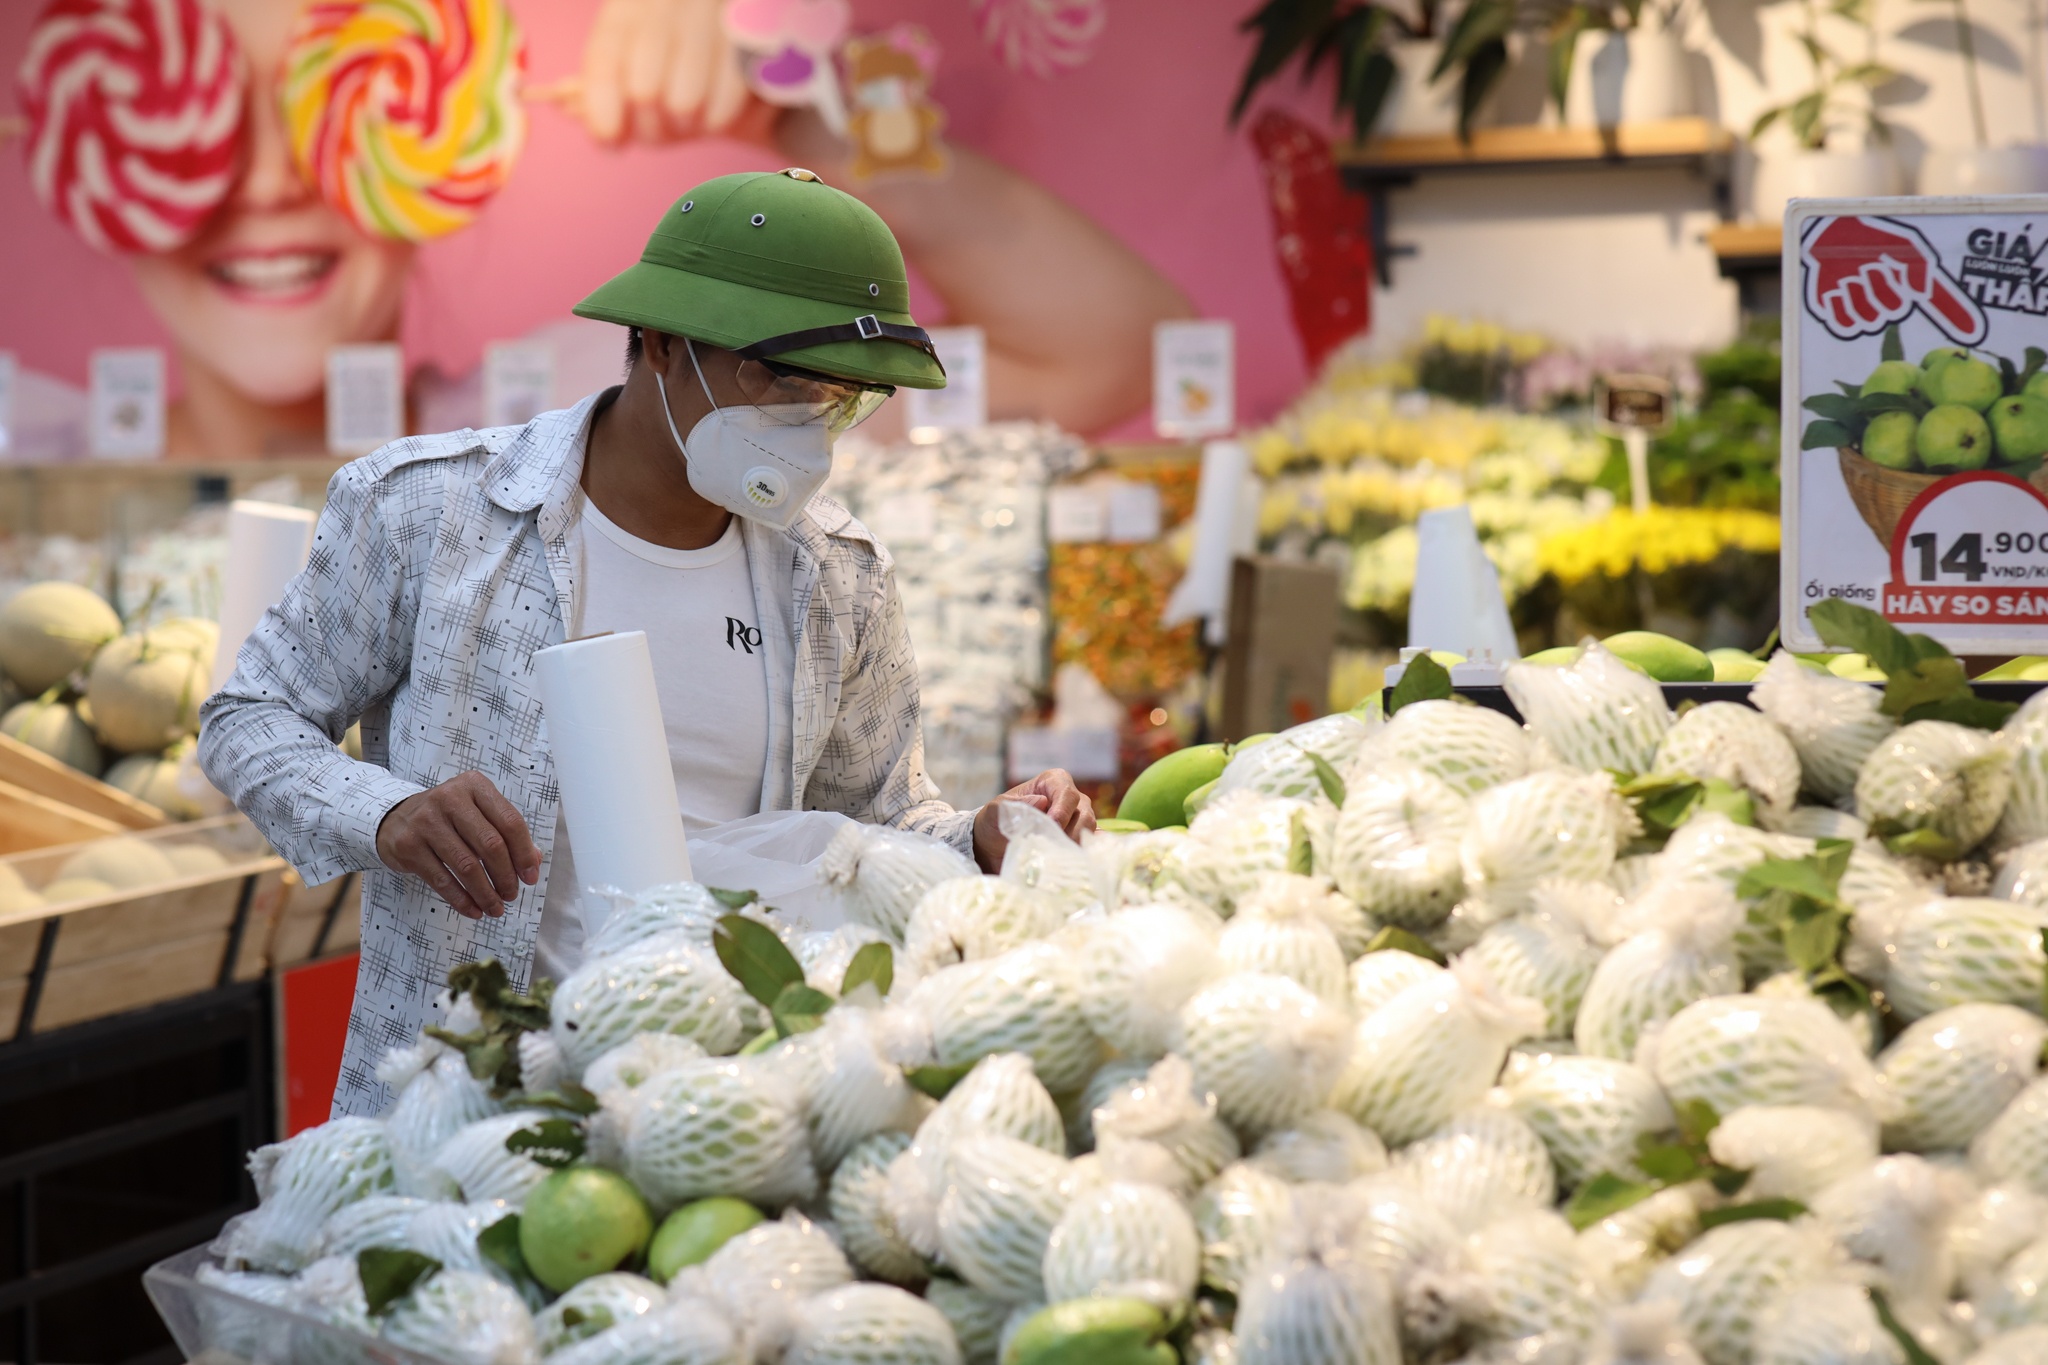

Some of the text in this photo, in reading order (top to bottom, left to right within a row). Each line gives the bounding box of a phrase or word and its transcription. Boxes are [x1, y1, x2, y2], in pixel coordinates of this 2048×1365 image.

[1967, 223, 2032, 262] GIÁ
[1992, 565, 2048, 580] VND/K
[1805, 578, 1876, 601] Ối giống
[1887, 590, 1947, 615] HÃY
[1951, 595, 1991, 616] SO
